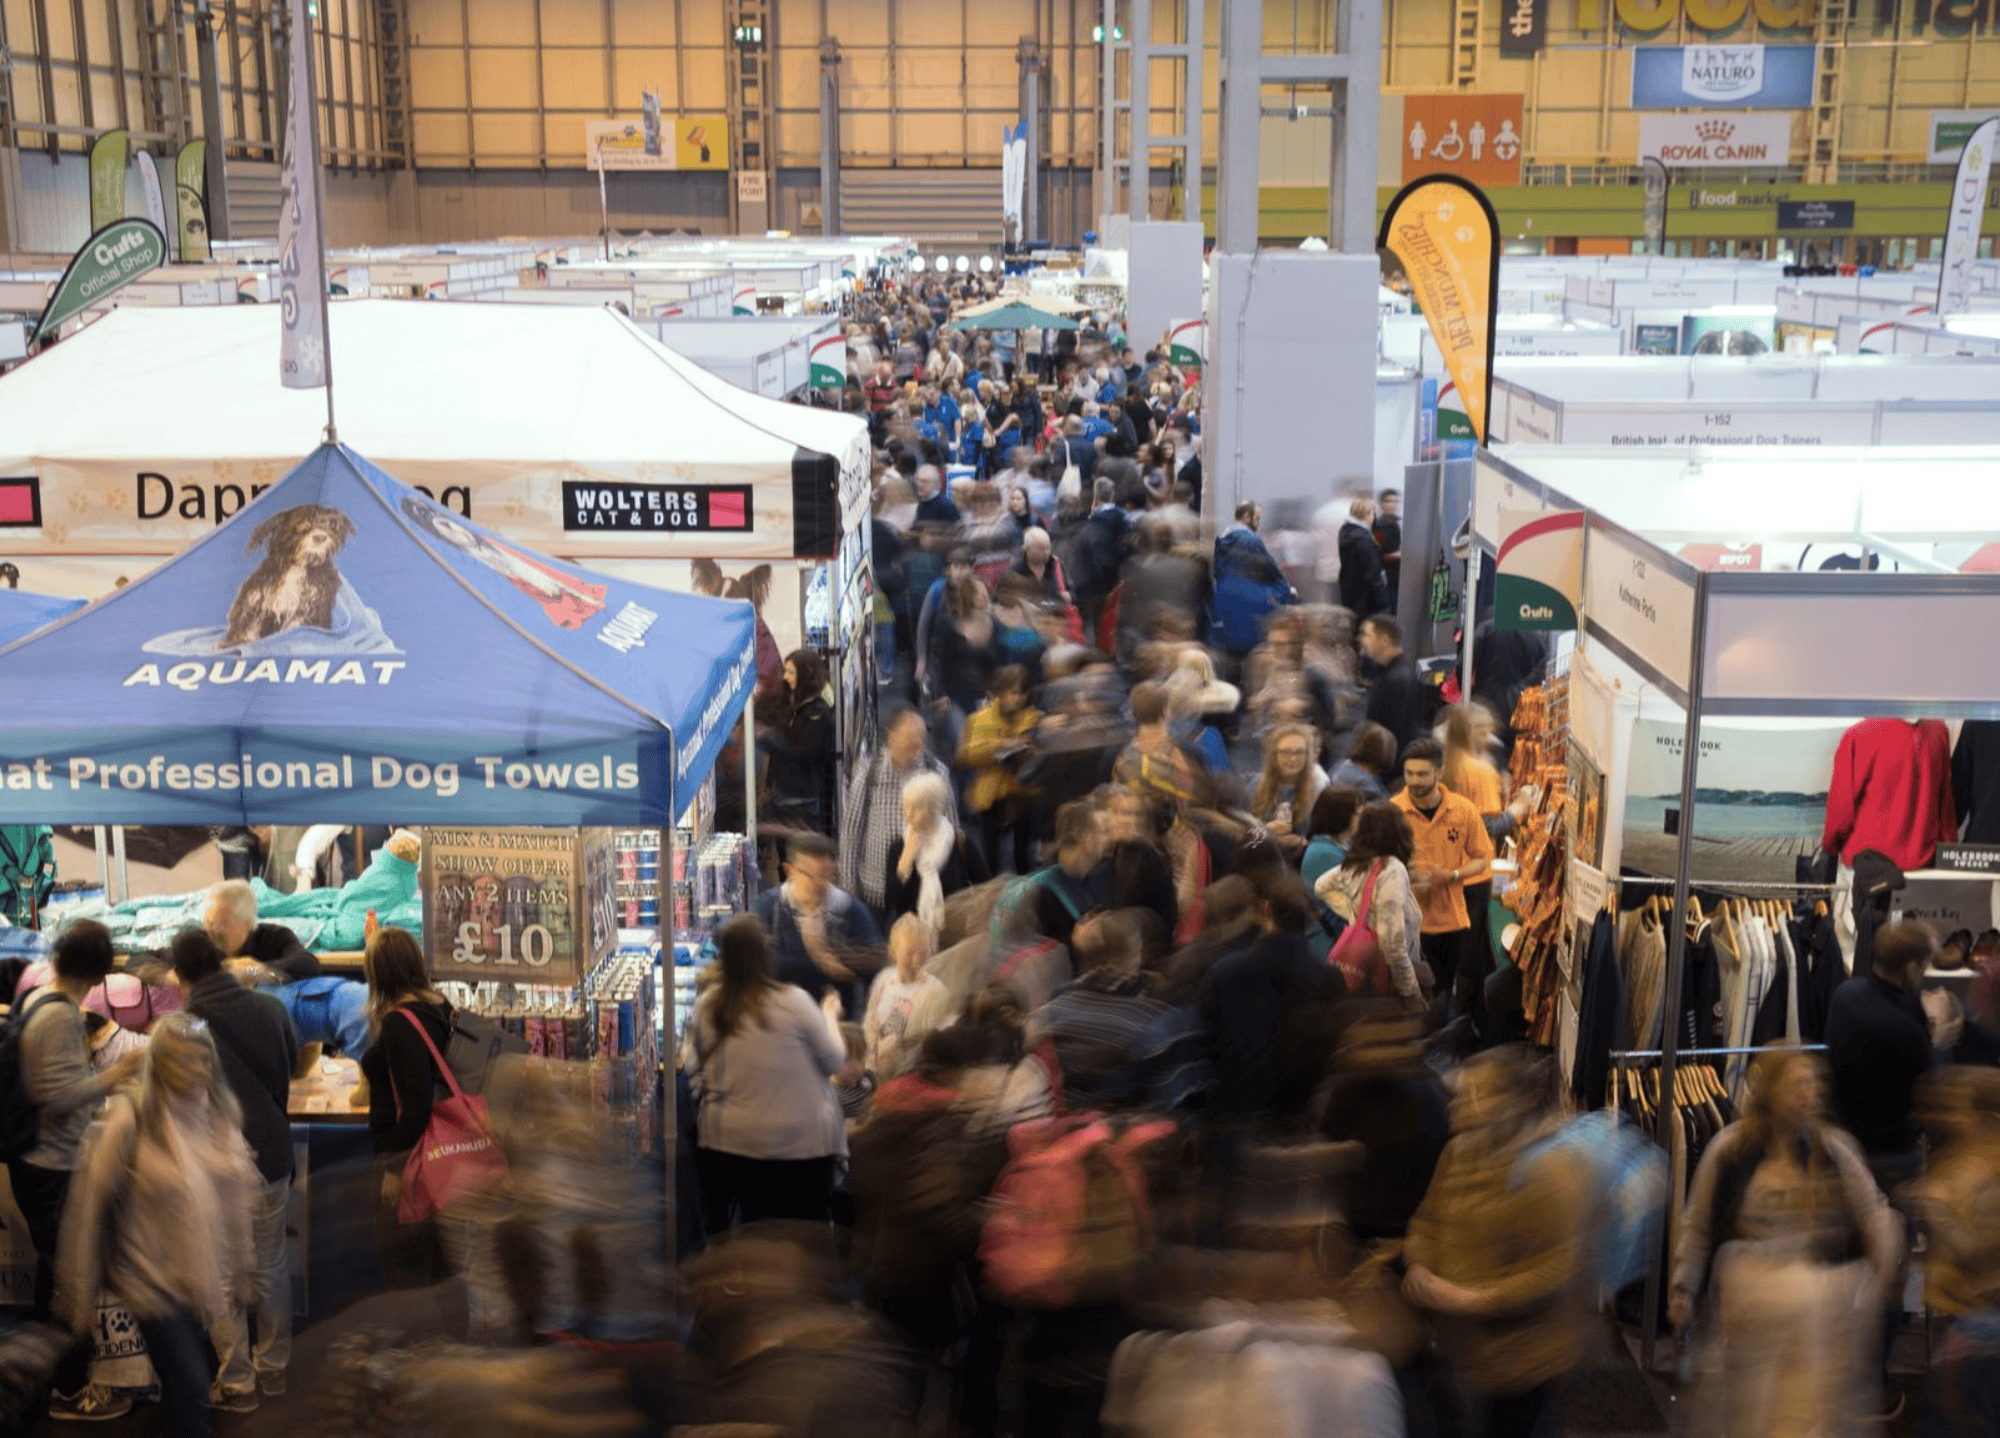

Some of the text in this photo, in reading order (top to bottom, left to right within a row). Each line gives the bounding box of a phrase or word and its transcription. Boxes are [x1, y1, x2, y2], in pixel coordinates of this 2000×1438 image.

[1691, 66, 1755, 80] NATURO
[1661, 145, 1768, 160] ROYAL CANIN
[1700, 189, 1737, 206] food
[95, 230, 145, 265] Crufts
[80, 249, 153, 296] Official Shop
[1704, 414, 1732, 426] 1-152
[1611, 434, 1645, 446] British
[1674, 434, 1686, 446] of
[1689, 434, 1754, 446] Professional
[1782, 434, 1822, 446] Trainers
[575, 489, 698, 510] WOLTERS
[577, 510, 698, 527] CAT & DOG
[1519, 603, 1553, 619] Crufts
[597, 599, 659, 654] AQUAMAT
[122, 658, 406, 691] AQUAMAT
[1656, 735, 1721, 751] HOLEOOK
[69, 755, 352, 791] Professional
[372, 756, 459, 796] Dog
[474, 755, 639, 790] Towels
[431, 832, 573, 850] MIX & MATCH
[435, 855, 569, 876] SHOW OFFER
[437, 884, 569, 904] ANY 2 ITEMS
[453, 921, 554, 967] £10
